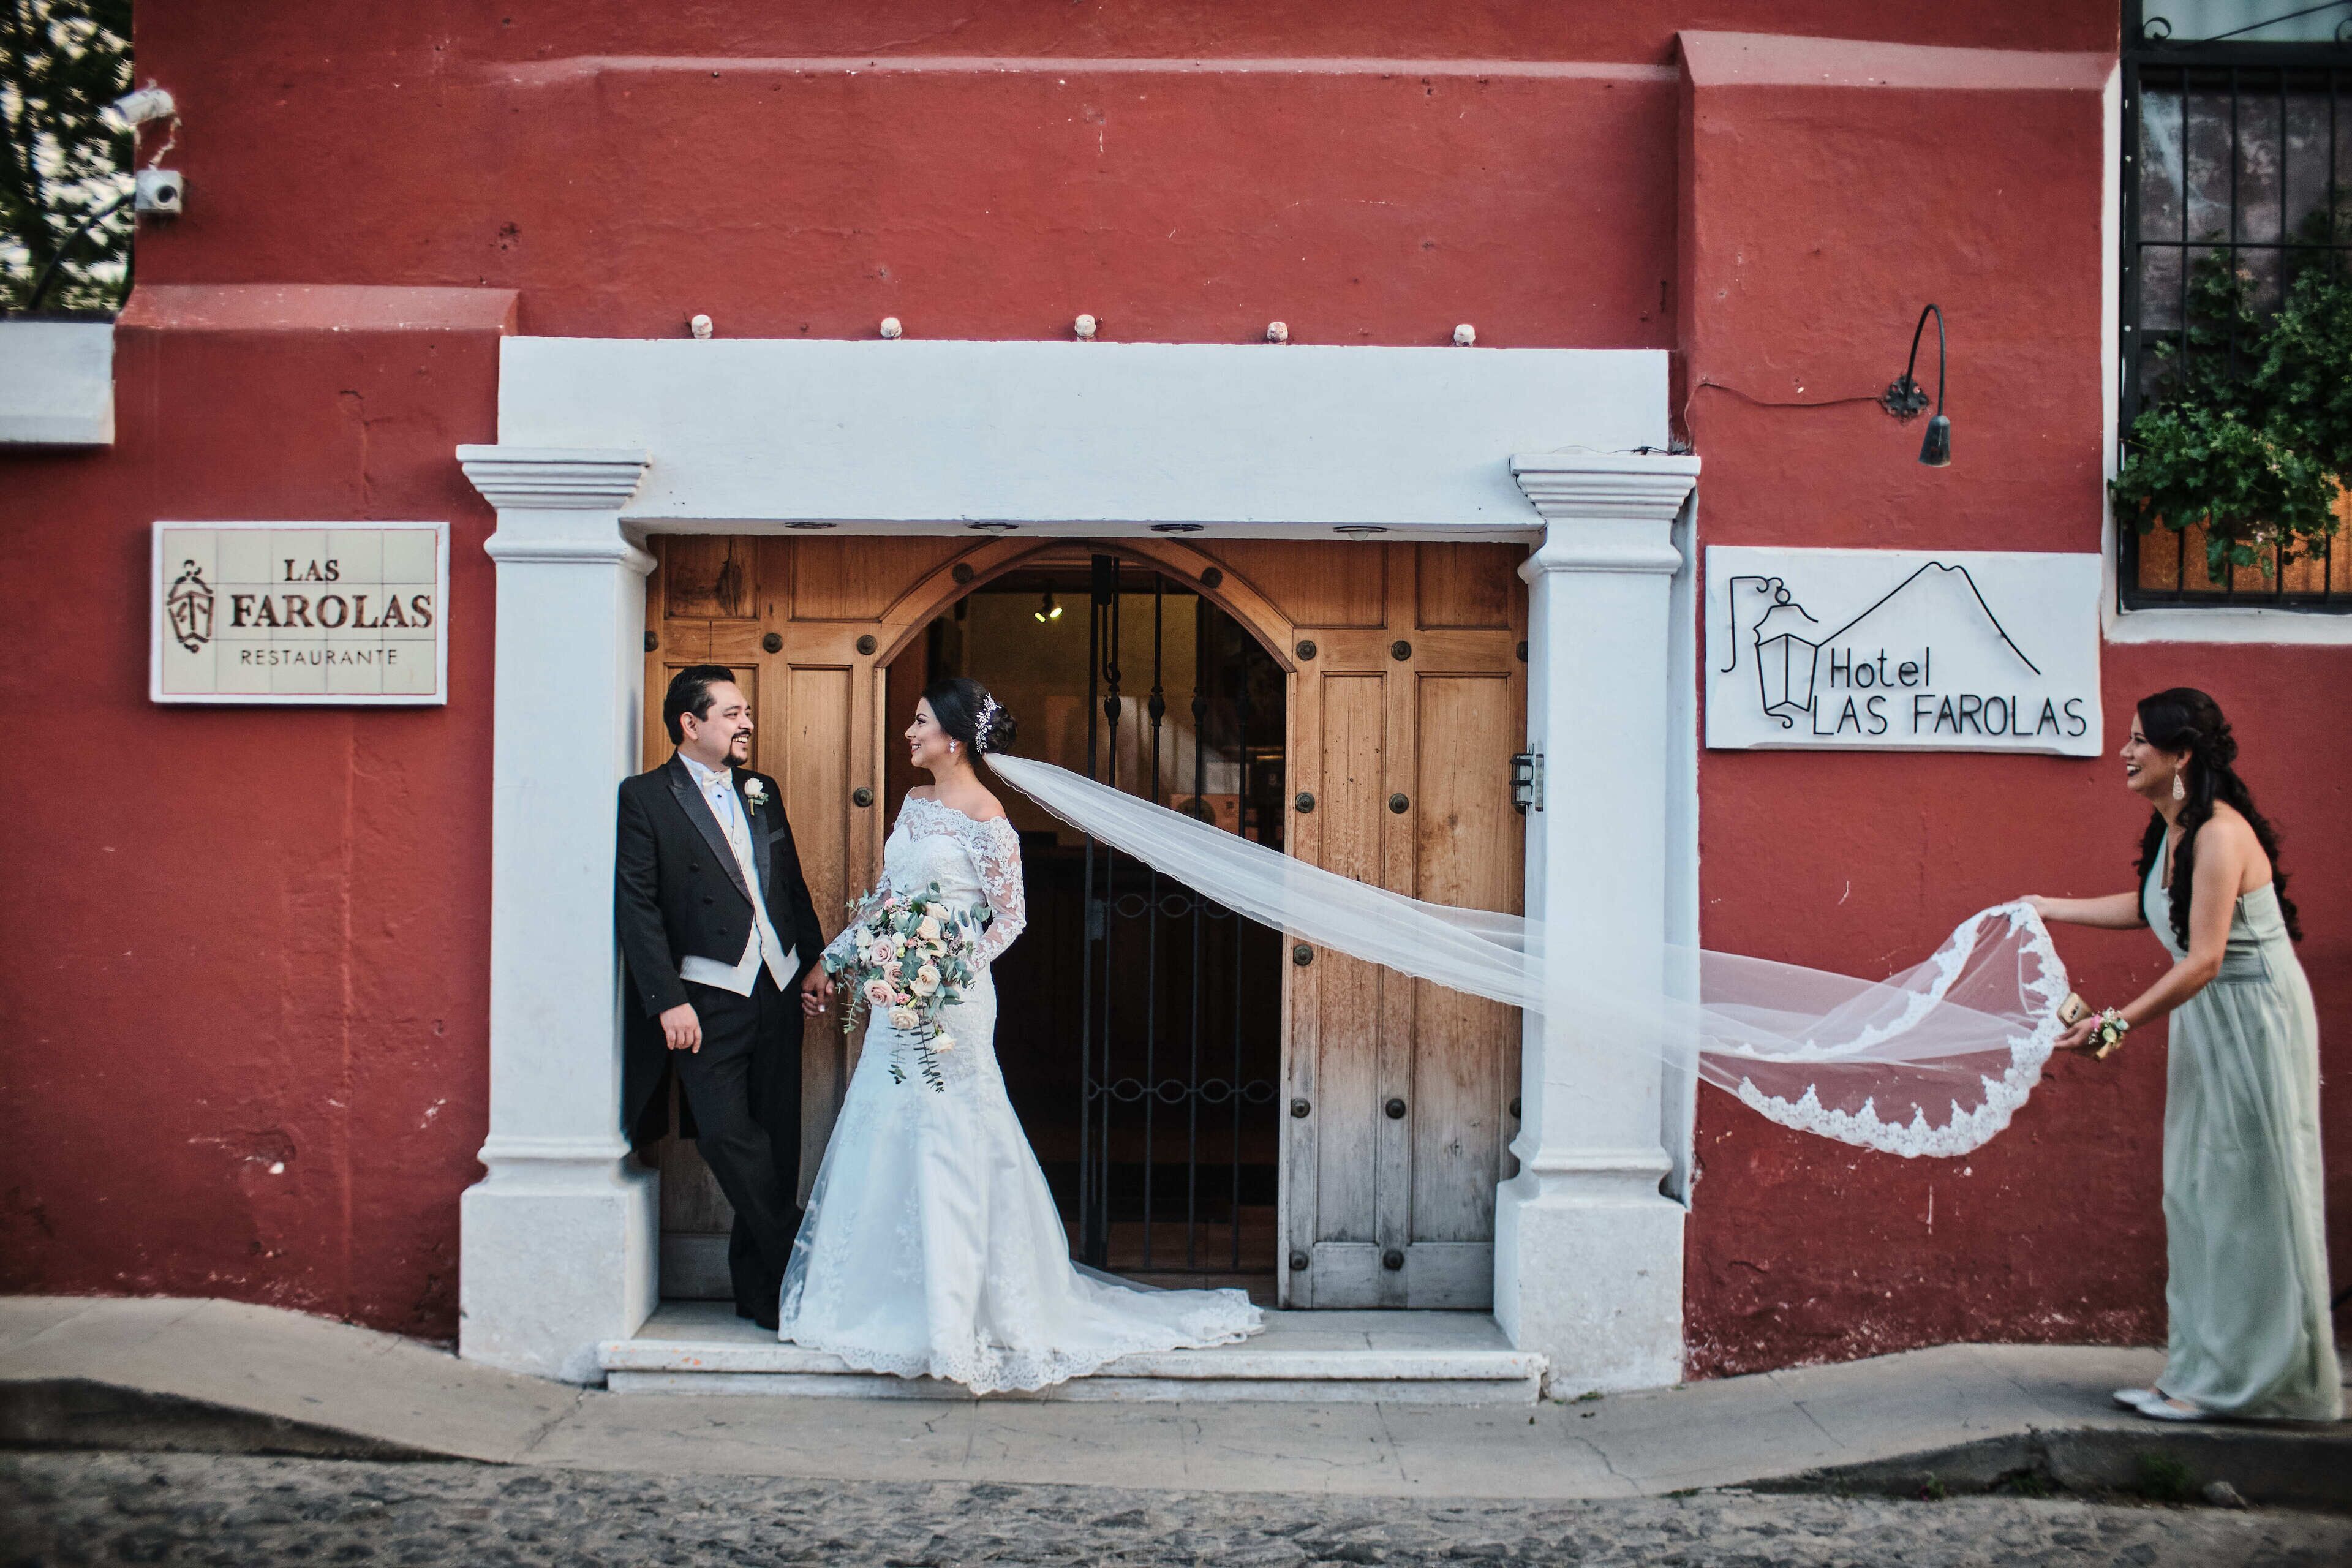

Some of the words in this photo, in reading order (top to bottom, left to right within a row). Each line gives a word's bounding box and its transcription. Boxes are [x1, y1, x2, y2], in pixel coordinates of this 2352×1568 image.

[284, 559, 340, 582] LAS
[230, 594, 434, 628] FAROLAS
[241, 649, 398, 666] RESTAURANTE
[1831, 647, 1930, 688] Hotel
[1813, 695, 1888, 735] LAS
[1914, 695, 2087, 737] FAROLAS
